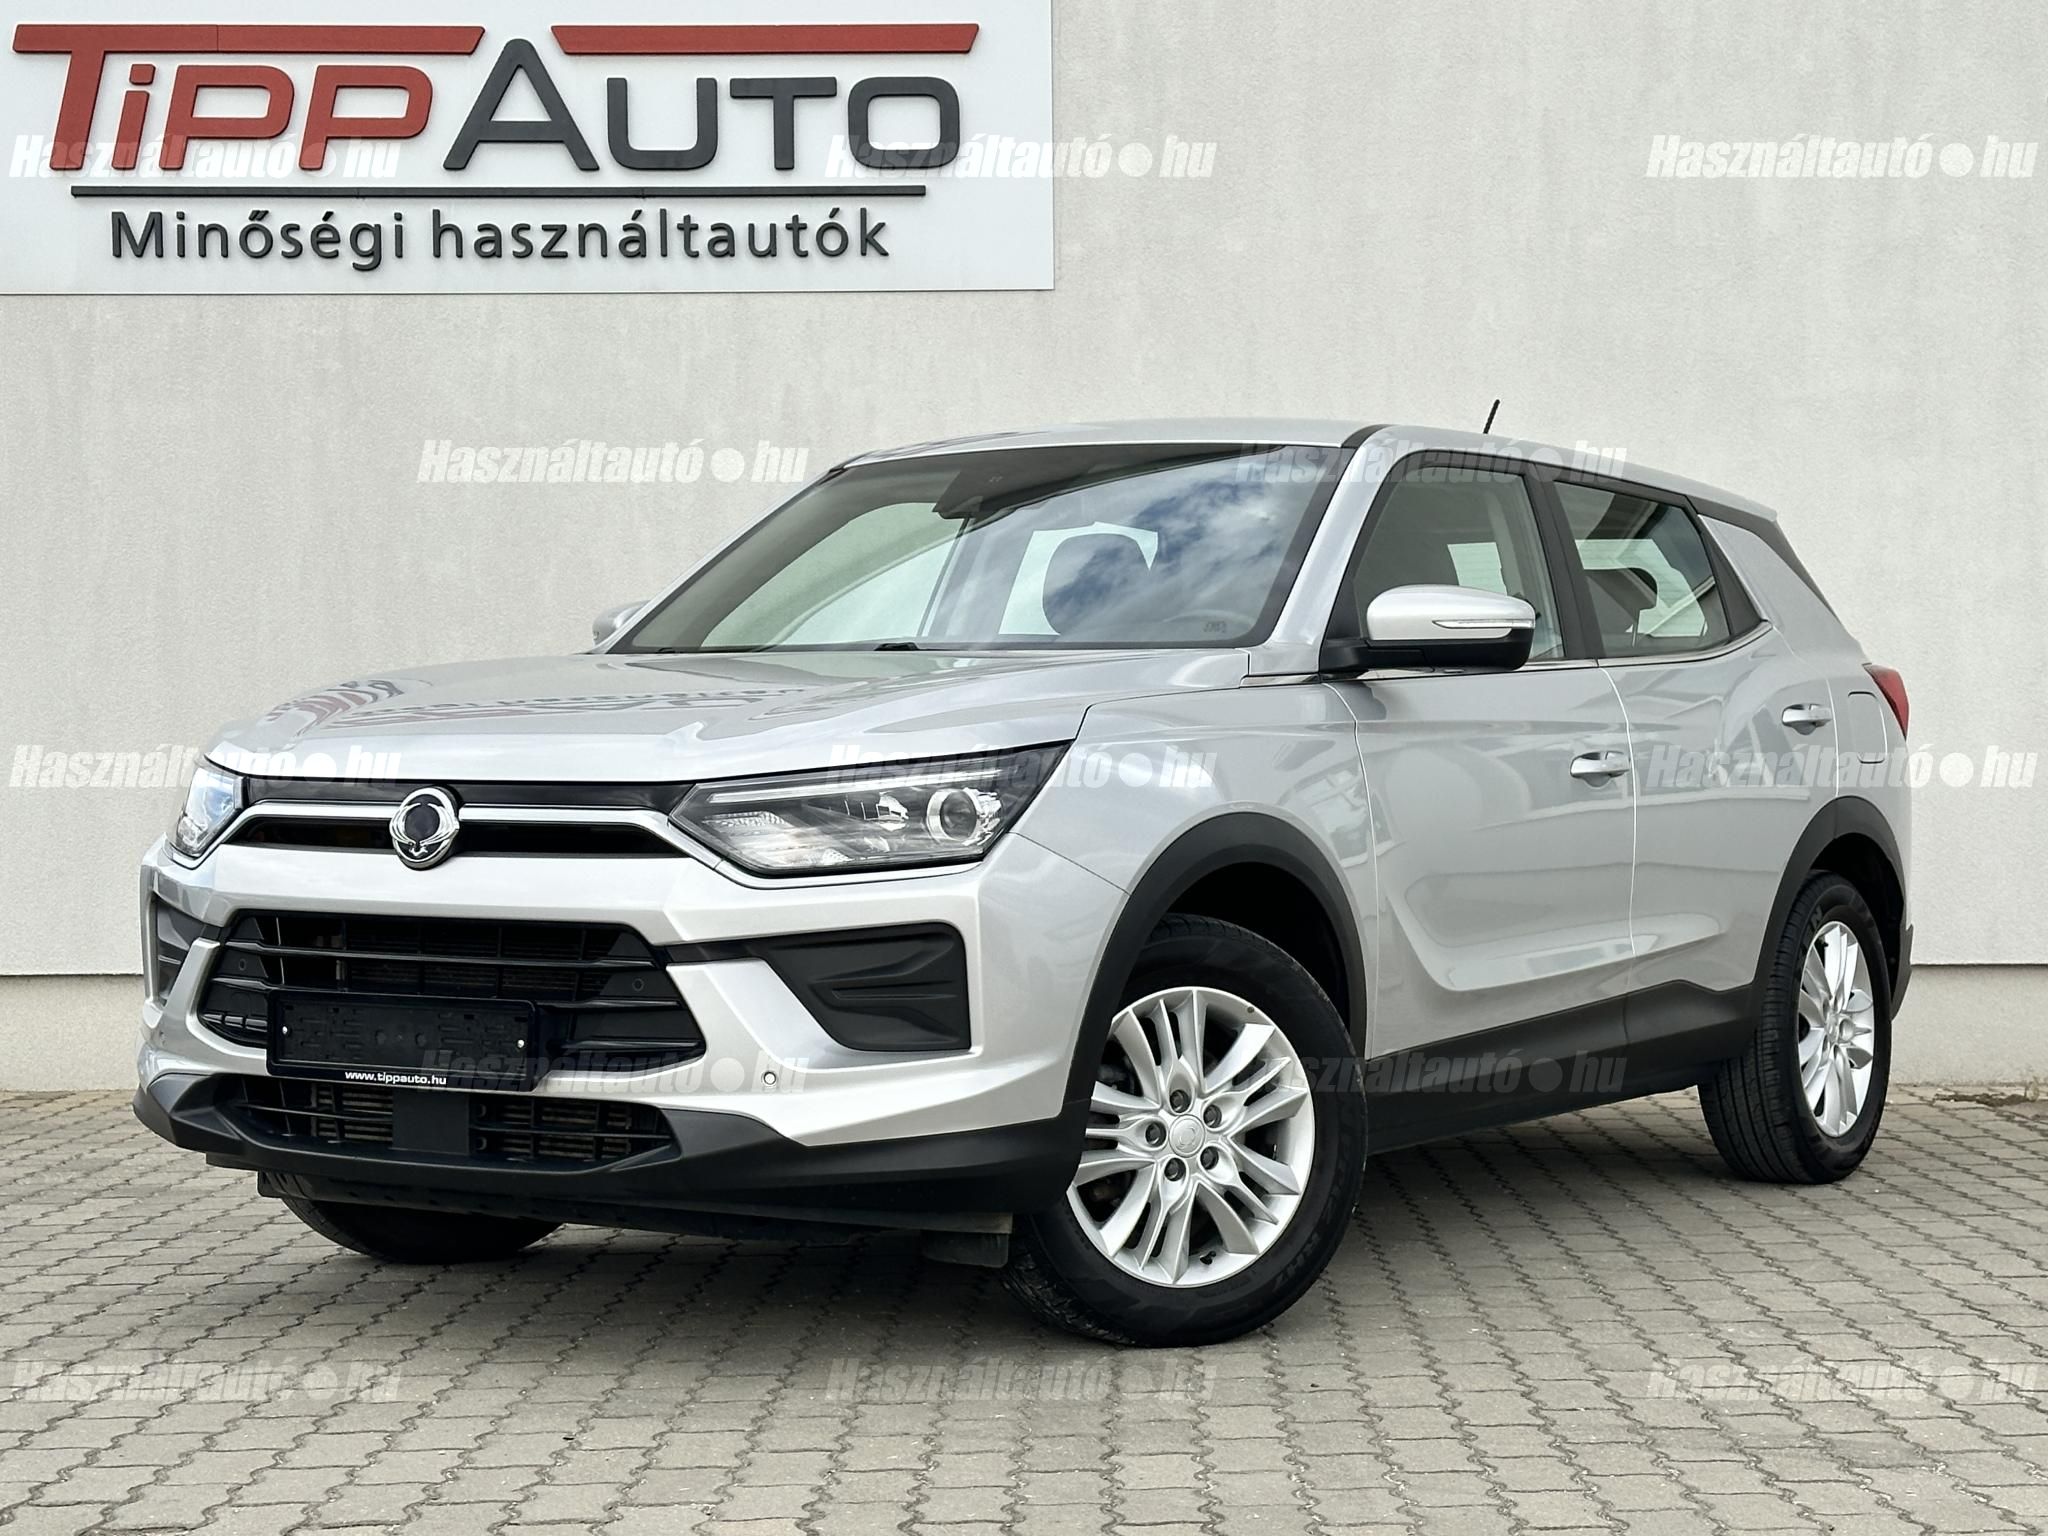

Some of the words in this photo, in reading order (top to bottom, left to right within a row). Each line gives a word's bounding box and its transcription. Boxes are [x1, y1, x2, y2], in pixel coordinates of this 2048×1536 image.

[110, 208, 404, 271] Minőségi
[432, 207, 889, 258] használtautók
[344, 1071, 447, 1085] www.tippauto.hu
